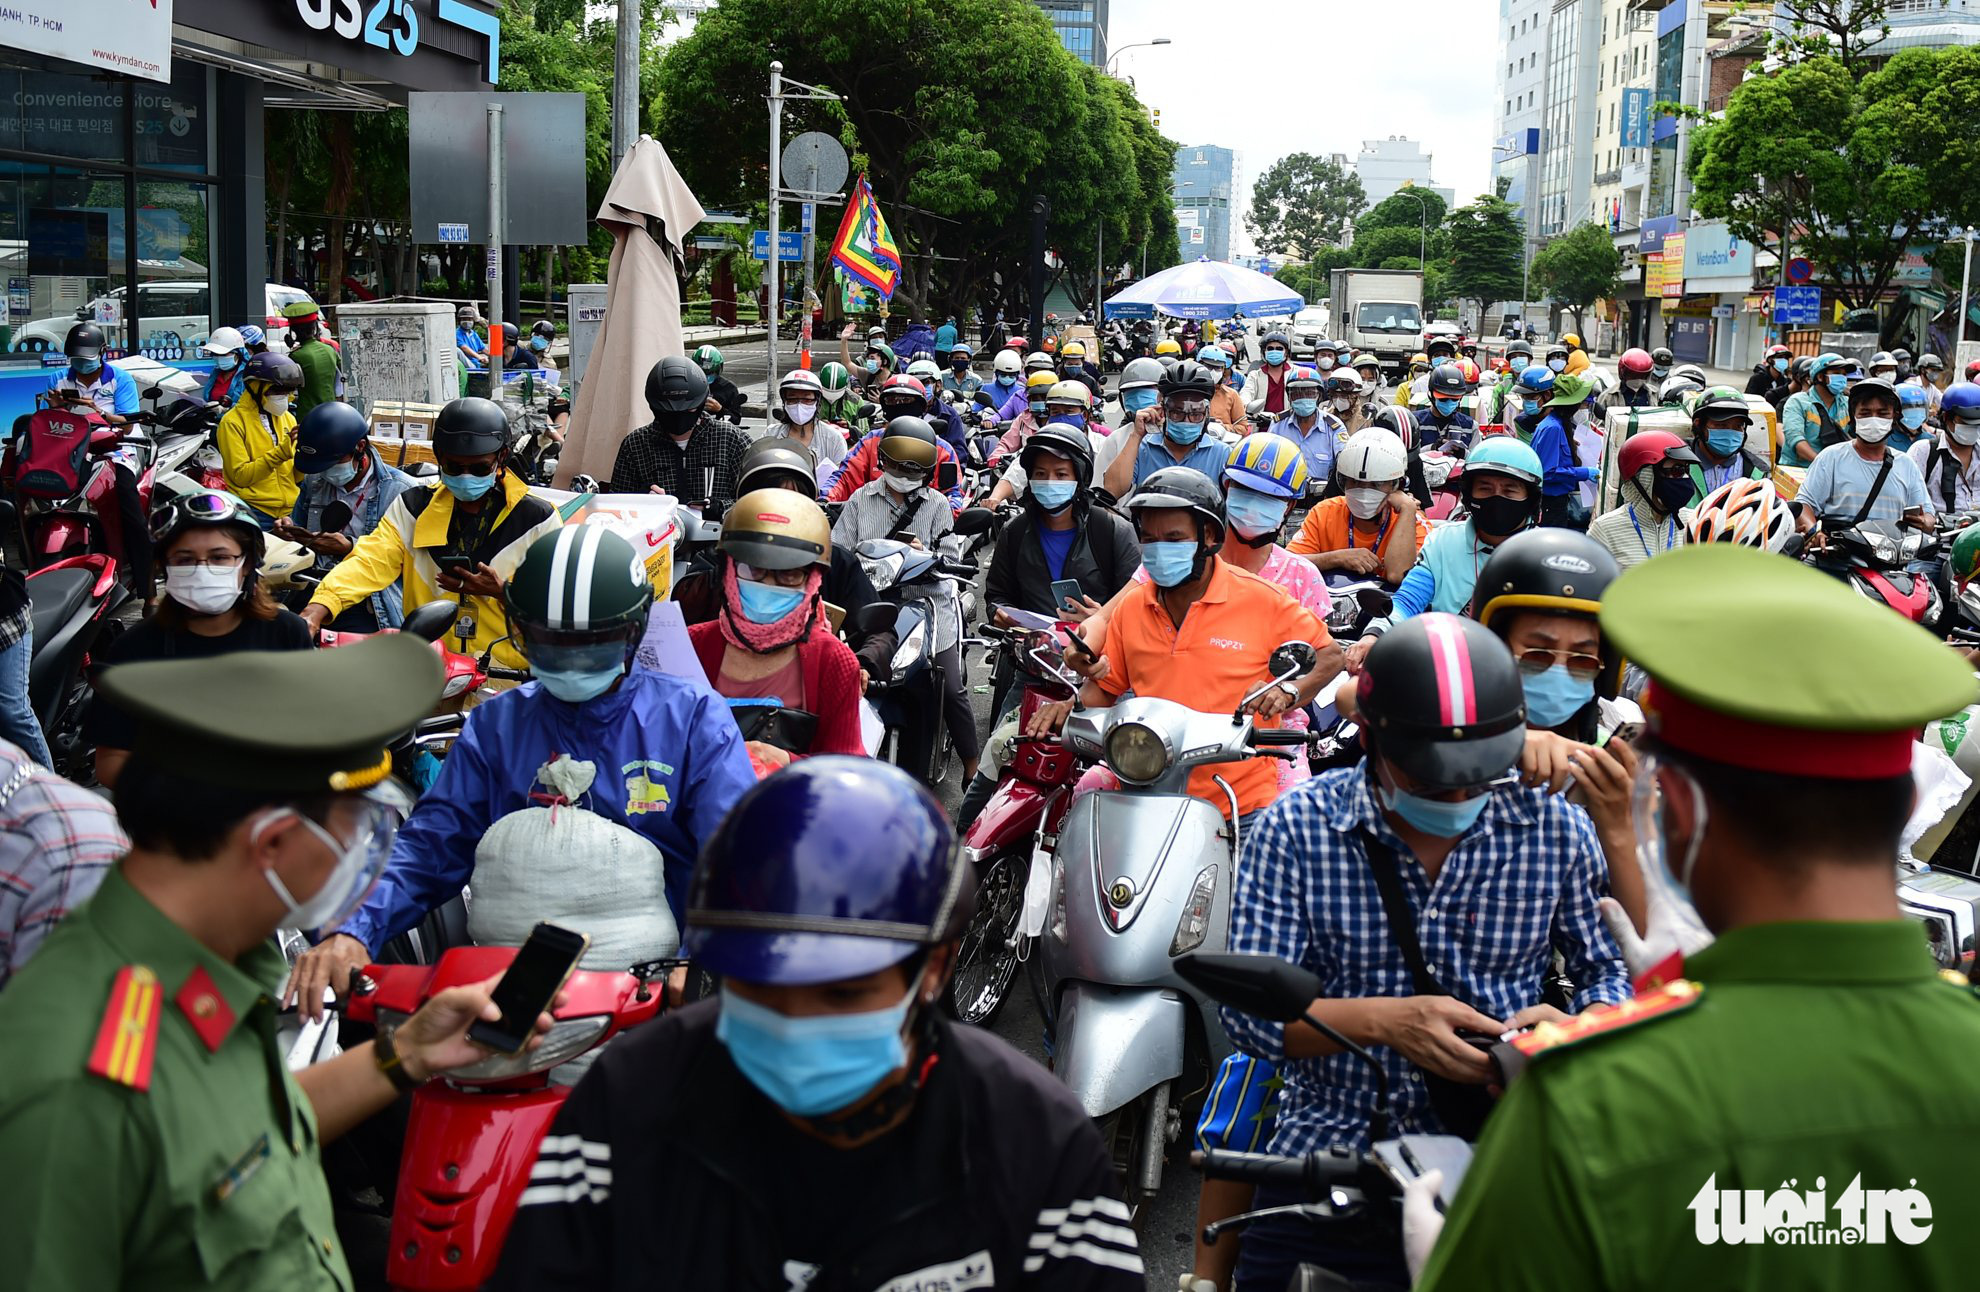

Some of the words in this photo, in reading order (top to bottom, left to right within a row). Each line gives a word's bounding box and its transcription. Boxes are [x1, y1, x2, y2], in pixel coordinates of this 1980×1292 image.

[0, 6, 24, 25] ẠNH,
[28, 14, 40, 28] TP.
[43, 18, 63, 33] HCM
[92, 48, 160, 73] www.kymdan.com
[13, 91, 123, 108] Convenience
[134, 93, 172, 109] tore
[1628, 92, 1639, 127] NCB
[1210, 637, 1245, 650] PROPZY
